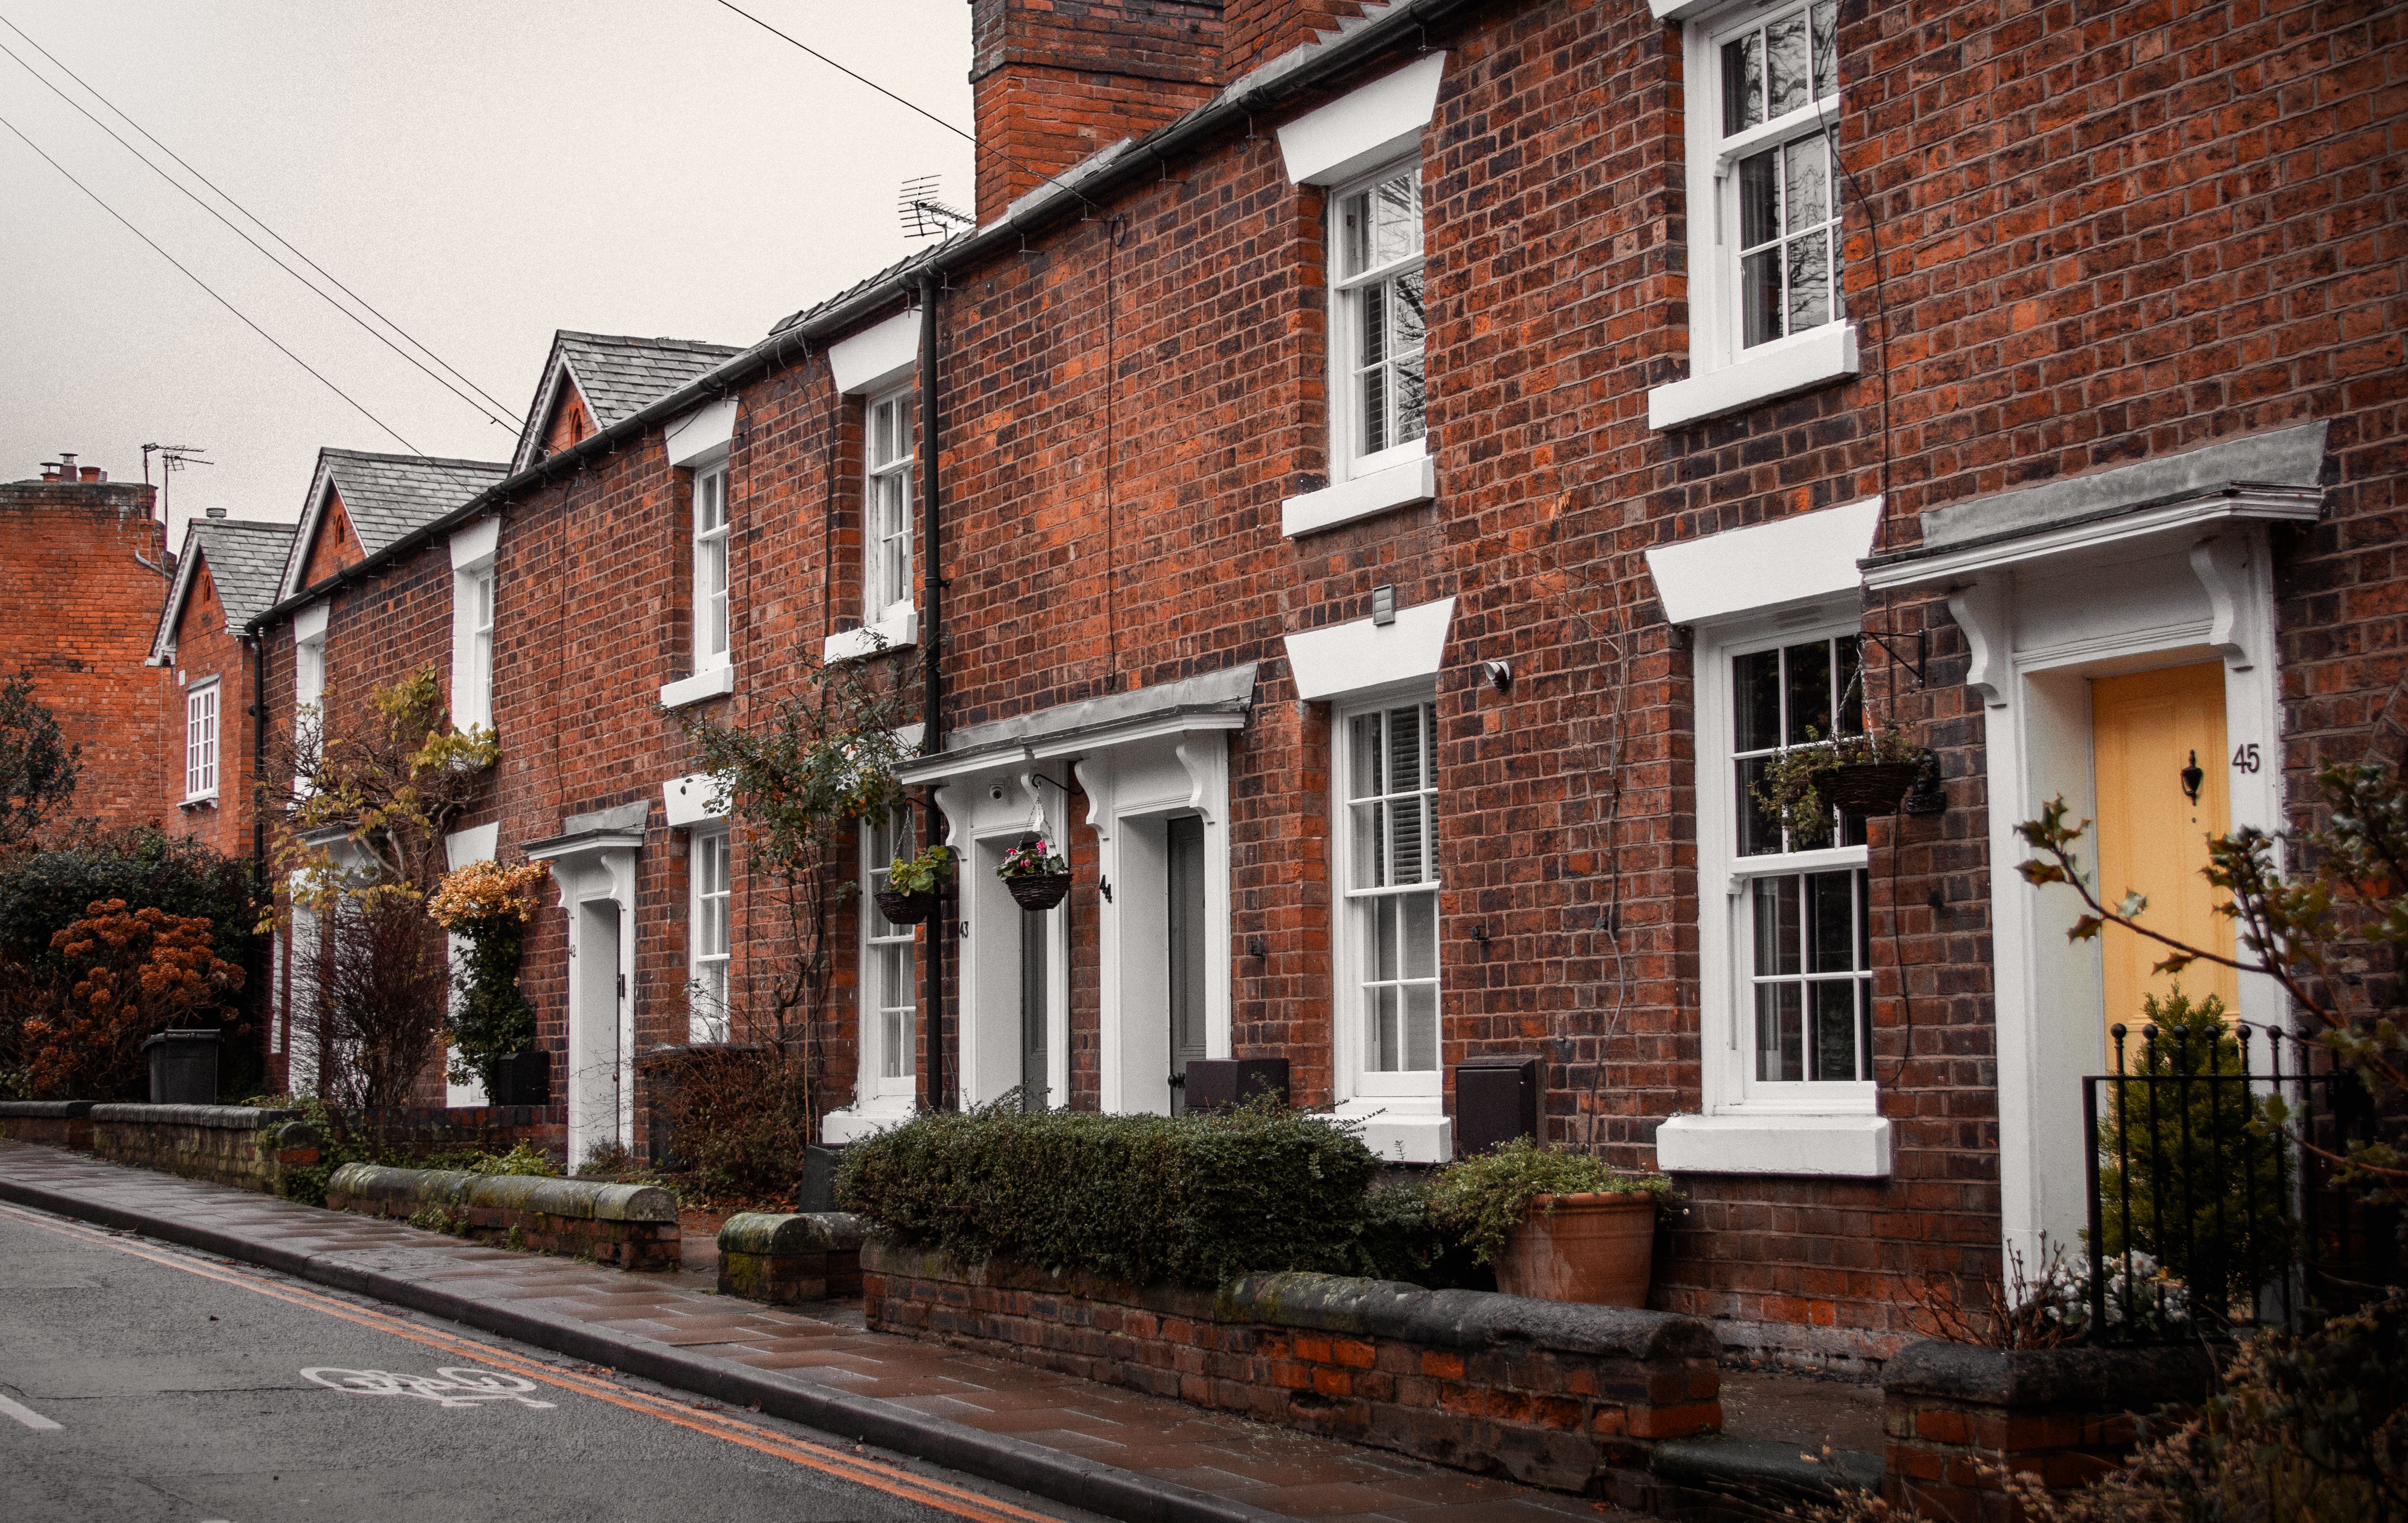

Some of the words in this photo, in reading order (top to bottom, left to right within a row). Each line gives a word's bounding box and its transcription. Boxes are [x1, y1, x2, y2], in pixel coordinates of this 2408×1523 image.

[2231, 743, 2260, 774] 45
[1099, 874, 1112, 904] 44
[960, 921, 968, 939] 43
